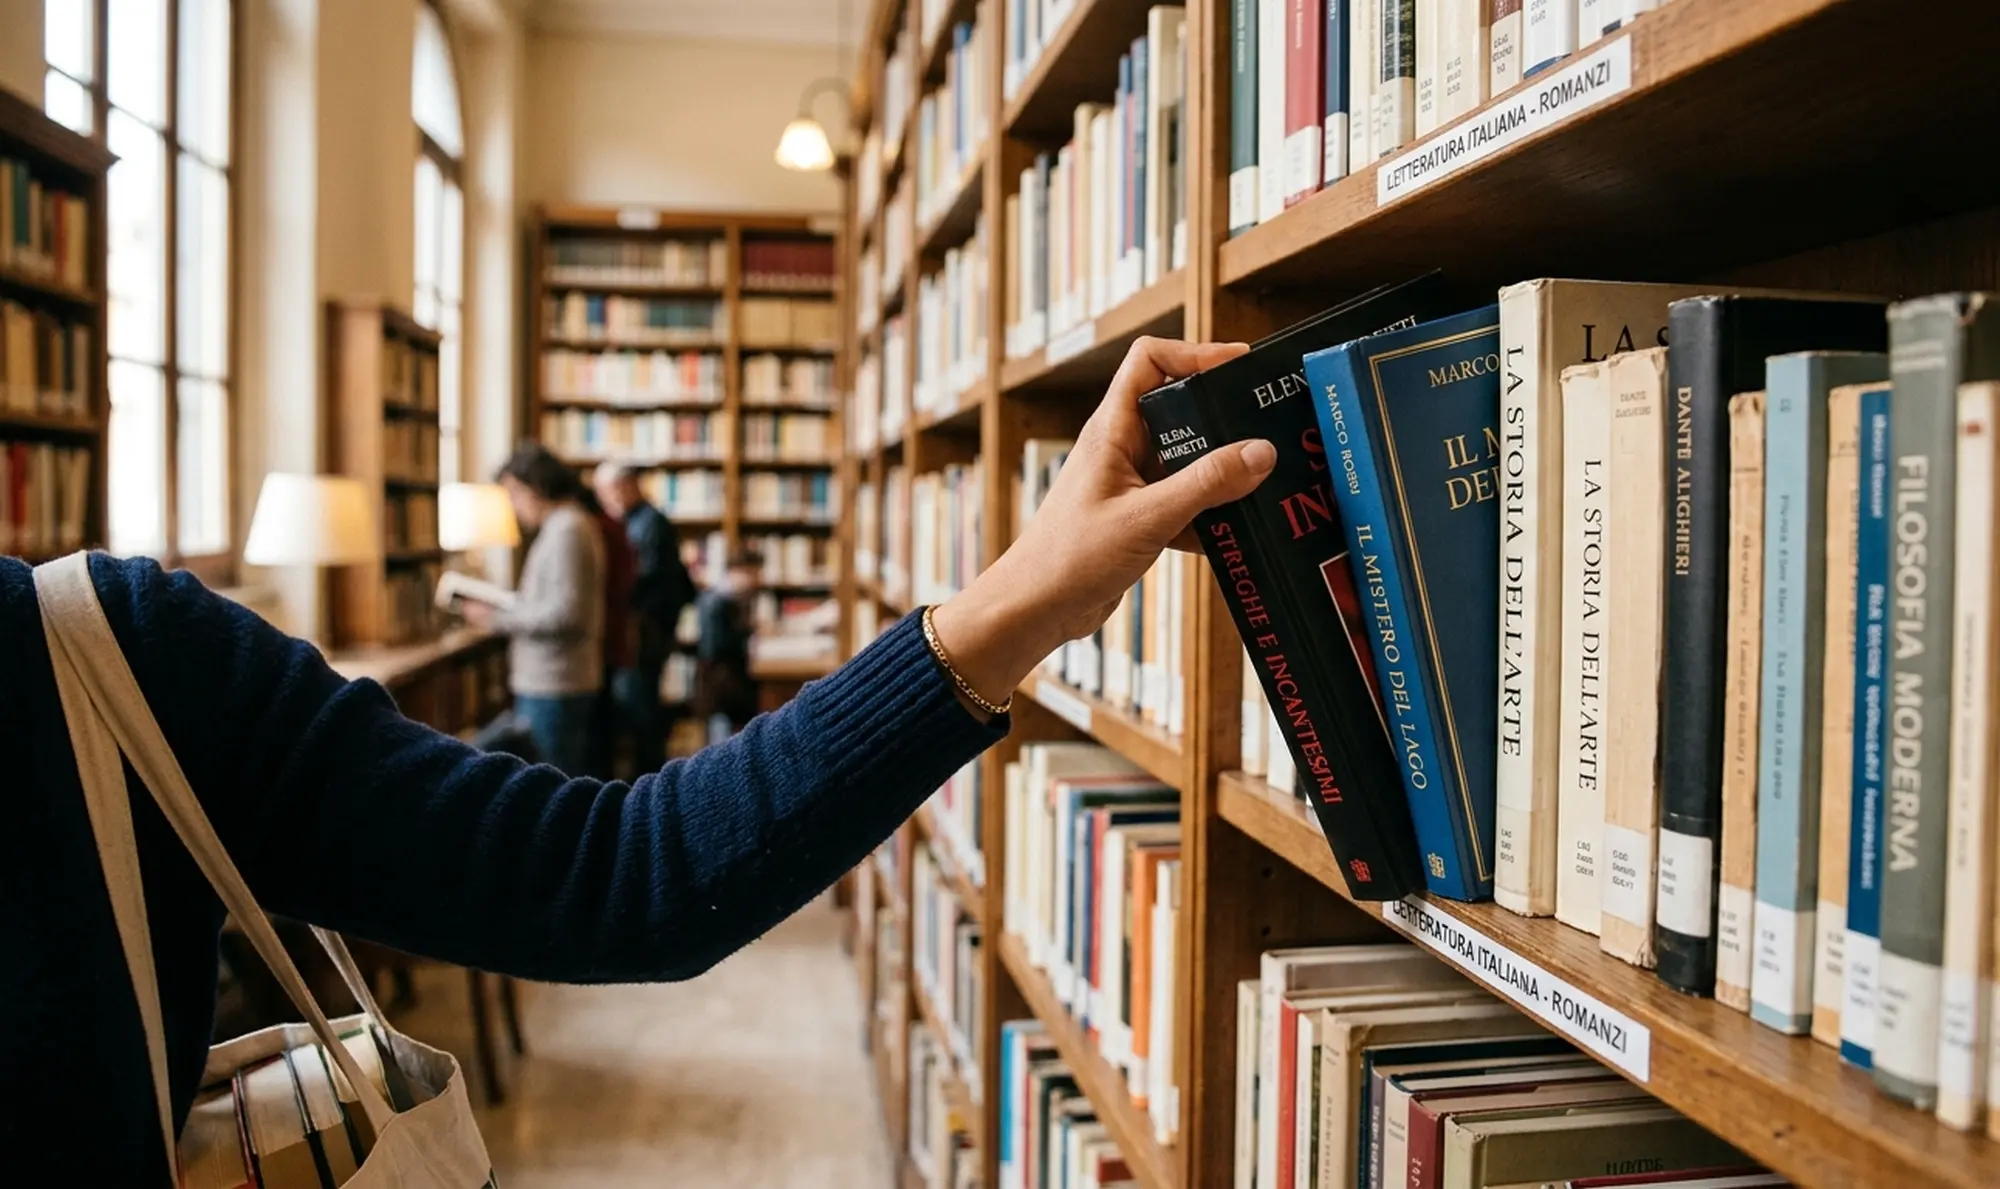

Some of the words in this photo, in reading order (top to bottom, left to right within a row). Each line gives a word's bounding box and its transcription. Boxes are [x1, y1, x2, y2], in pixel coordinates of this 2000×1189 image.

[1386, 135, 1466, 191] LETTERATURA
[1467, 103, 1527, 151] ITALIANA
[1539, 58, 1612, 115] ROMANZI
[1427, 353, 1500, 388] MARCO
[1506, 345, 1524, 395] LA
[1676, 386, 1693, 460] DANTE
[1442, 434, 1479, 470] IL
[1506, 406, 1525, 544] STORIA
[1584, 459, 1602, 498] LA
[1355, 524, 1374, 549] IL
[1582, 508, 1602, 620] STORIA
[1675, 467, 1692, 576] ALIGHIERI
[1895, 454, 1929, 660] FILOSOFIA
[1210, 521, 1271, 629] STREGHE
[1256, 632, 1279, 649] E
[1362, 553, 1401, 664] MISTERO
[1389, 671, 1411, 717] DEL
[1502, 556, 1524, 757] DELL'ARTE
[1578, 632, 1600, 791] DELL'ARTE
[1400, 723, 1428, 790] LAGO
[1888, 670, 1924, 873] MODERNA
[1477, 944, 1540, 1002] ITALIANA
[1551, 989, 1628, 1054] ROMANZI
